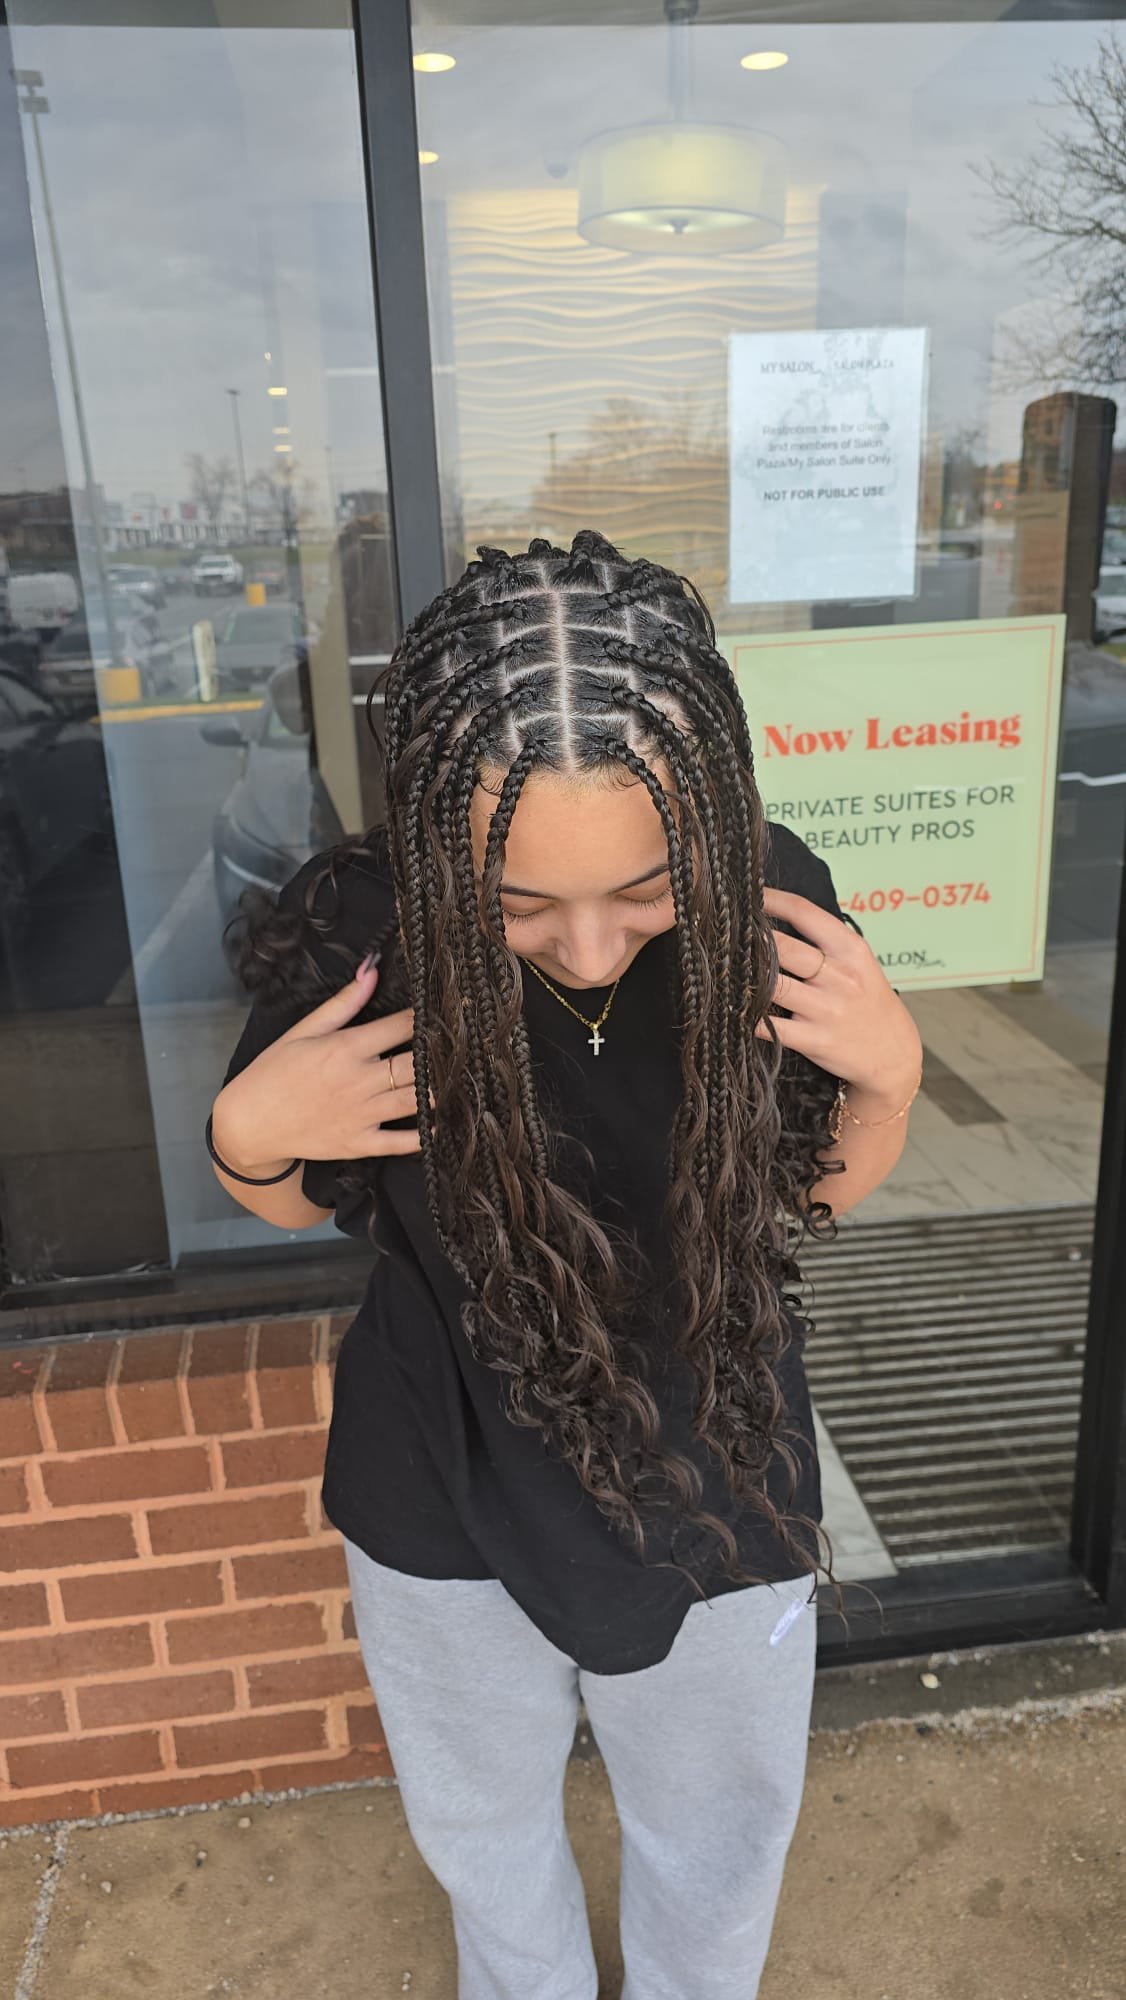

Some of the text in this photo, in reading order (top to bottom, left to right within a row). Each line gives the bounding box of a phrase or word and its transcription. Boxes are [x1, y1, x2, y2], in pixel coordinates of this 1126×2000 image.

[840, 422, 854, 432] for
[769, 438, 883, 451] and members of Salon
[807, 456, 836, 467] Salon
[839, 455, 866, 466] Suite
[764, 486, 885, 501] NOT FOR PUBLIC USE
[763, 711, 1021, 758] Now Leasing
[766, 785, 1015, 821] PRIVATE SUITES FOR
[805, 819, 976, 850] BEAUTY PROS
[877, 949, 927, 967] ALON
